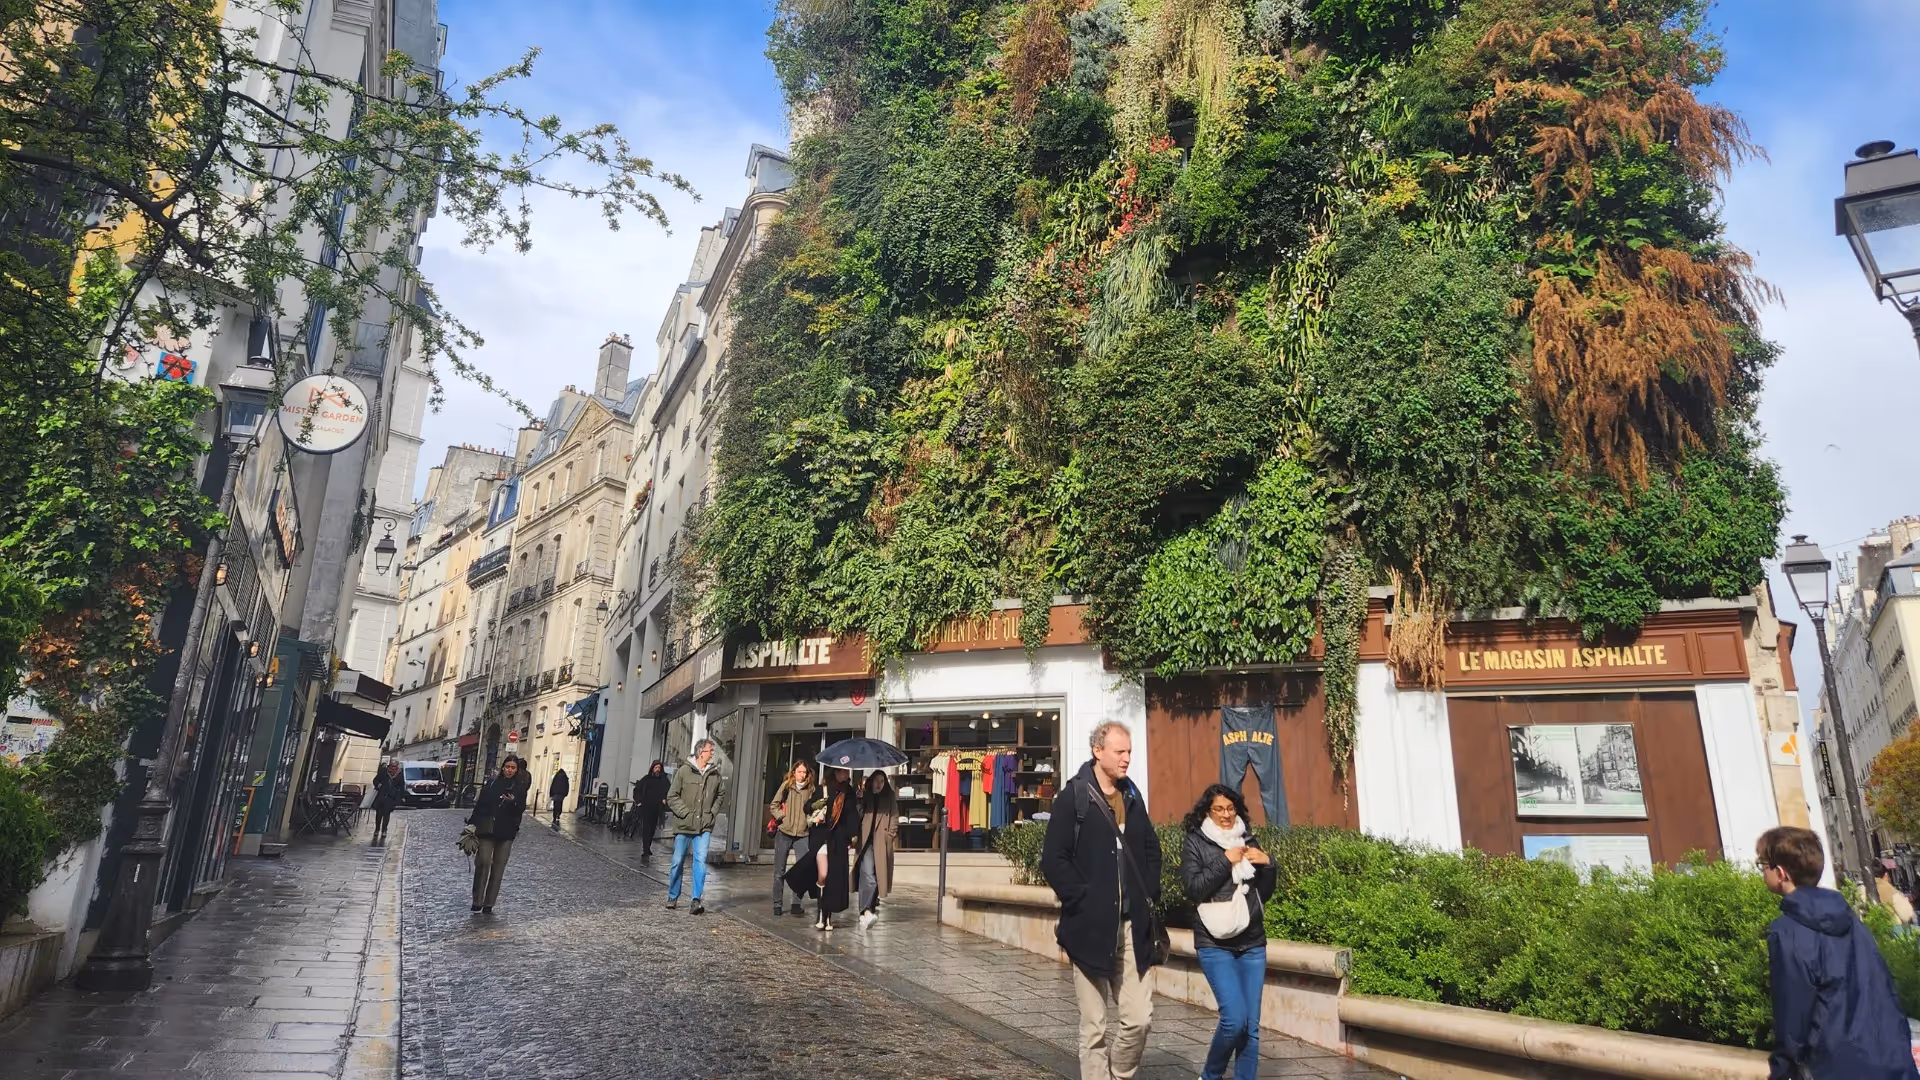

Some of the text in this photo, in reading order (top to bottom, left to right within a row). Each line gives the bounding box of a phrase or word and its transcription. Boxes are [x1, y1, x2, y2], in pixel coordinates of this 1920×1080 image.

[282, 405, 363, 423] MISTE GARDEN
[985, 617, 999, 641] DE
[733, 637, 832, 669] ASPHALTE
[1459, 645, 1667, 671] LE MAGASIN ASPHALTE
[1222, 730, 1274, 746] ASPH ALTE
